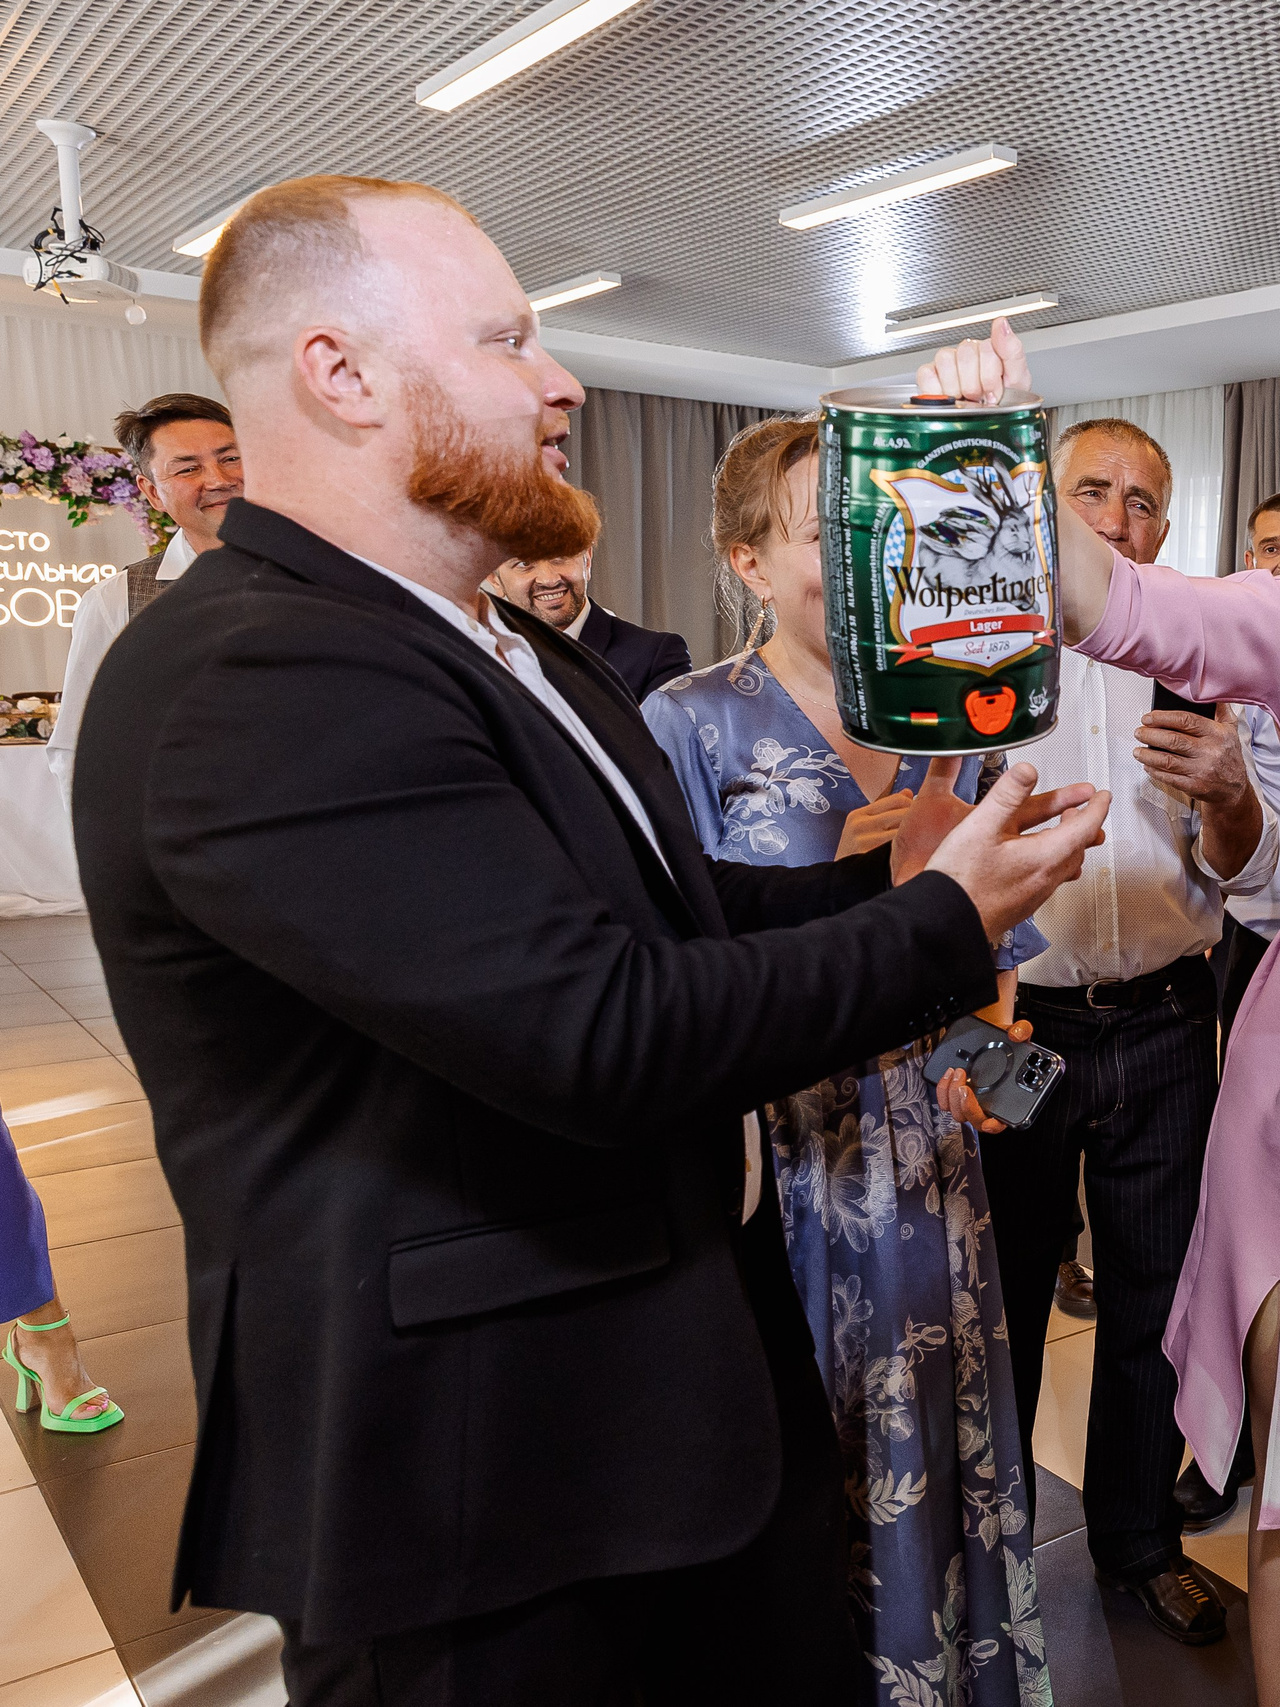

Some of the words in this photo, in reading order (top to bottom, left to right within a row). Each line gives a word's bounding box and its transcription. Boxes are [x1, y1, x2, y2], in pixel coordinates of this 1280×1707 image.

[887, 565, 1051, 618] Wolpertinger
[969, 619, 1003, 634] Lager
[964, 641, 985, 656] Seit
[988, 640, 1010, 653] 1878
